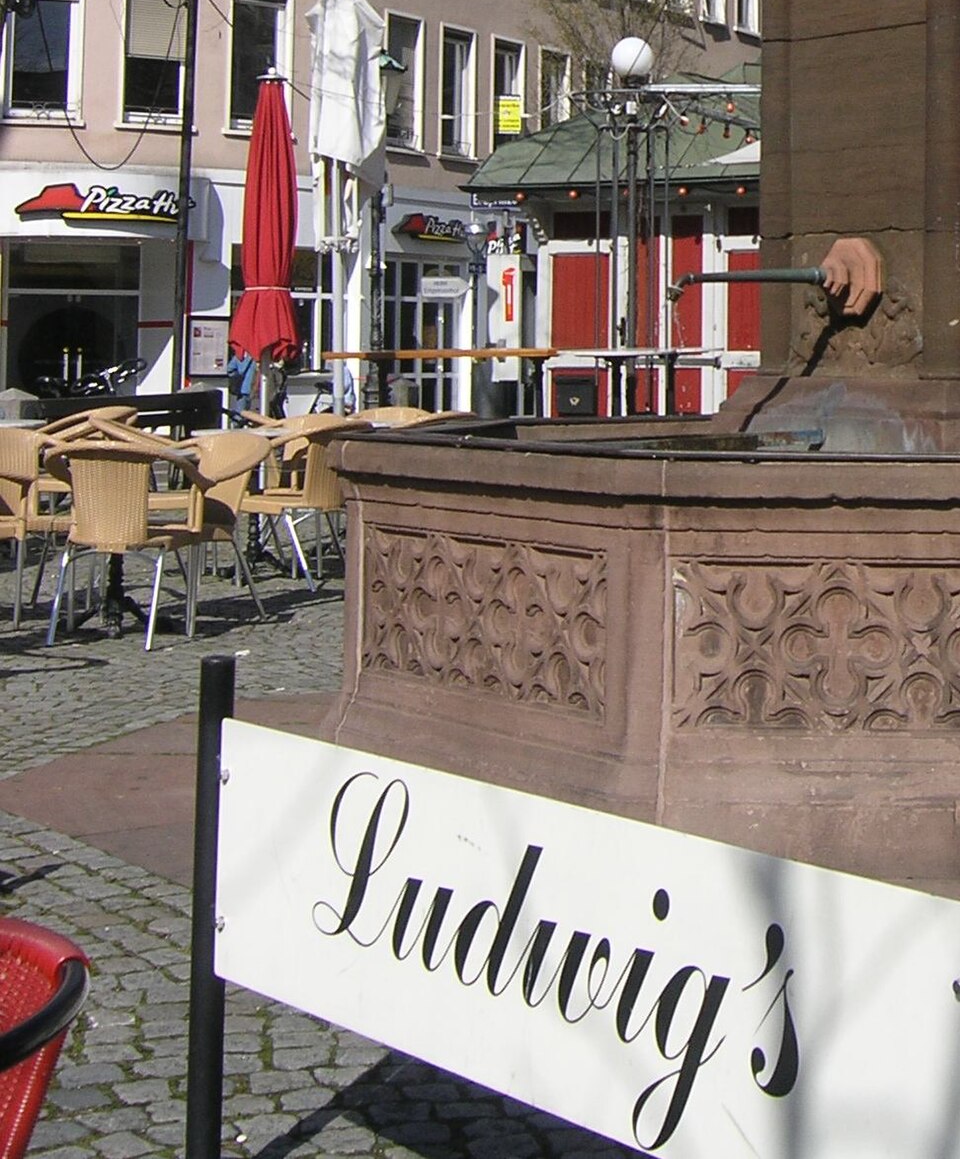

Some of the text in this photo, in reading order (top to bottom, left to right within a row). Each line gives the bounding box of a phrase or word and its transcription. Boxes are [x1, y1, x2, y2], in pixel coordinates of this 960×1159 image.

[80, 187, 150, 214] Pizza
[424, 217, 451, 235] Pizza
[312, 771, 800, 1151] Ludwig's
